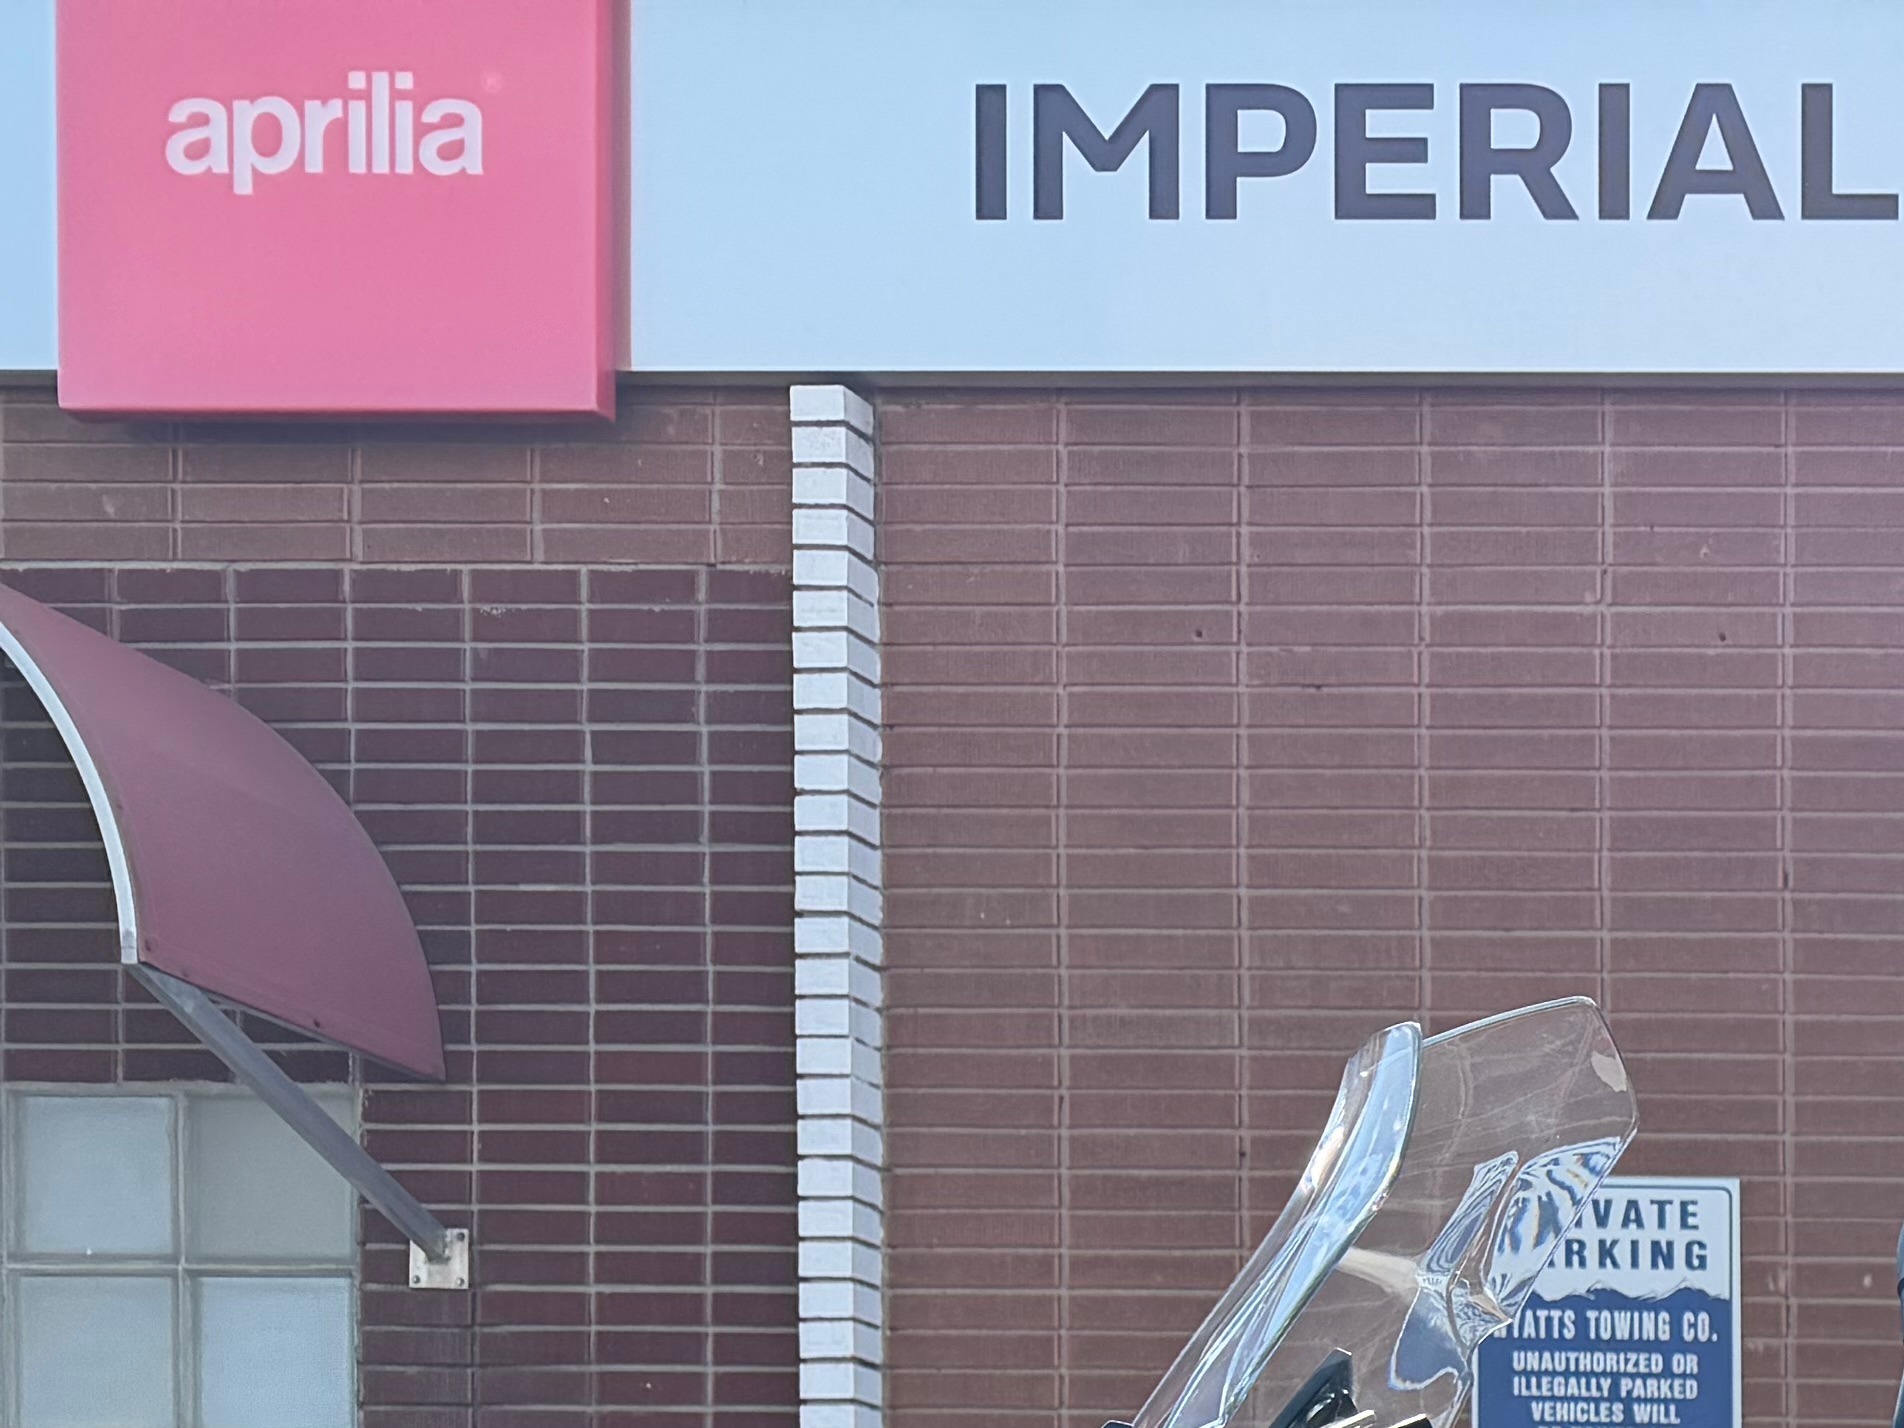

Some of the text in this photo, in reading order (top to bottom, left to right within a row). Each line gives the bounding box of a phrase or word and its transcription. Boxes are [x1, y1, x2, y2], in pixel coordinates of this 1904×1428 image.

[166, 70, 484, 195] aprilia
[973, 81, 1901, 222] IMPERIAL
[1586, 1310, 1671, 1342] TOWING
[1682, 1311, 1718, 1343] CO.
[1512, 1350, 1699, 1375] UNAUTHORIZED OR
[1513, 1375, 1698, 1400] ILLEGALLY PARKED
[1531, 1401, 1681, 1425] VEHICLES WILL
